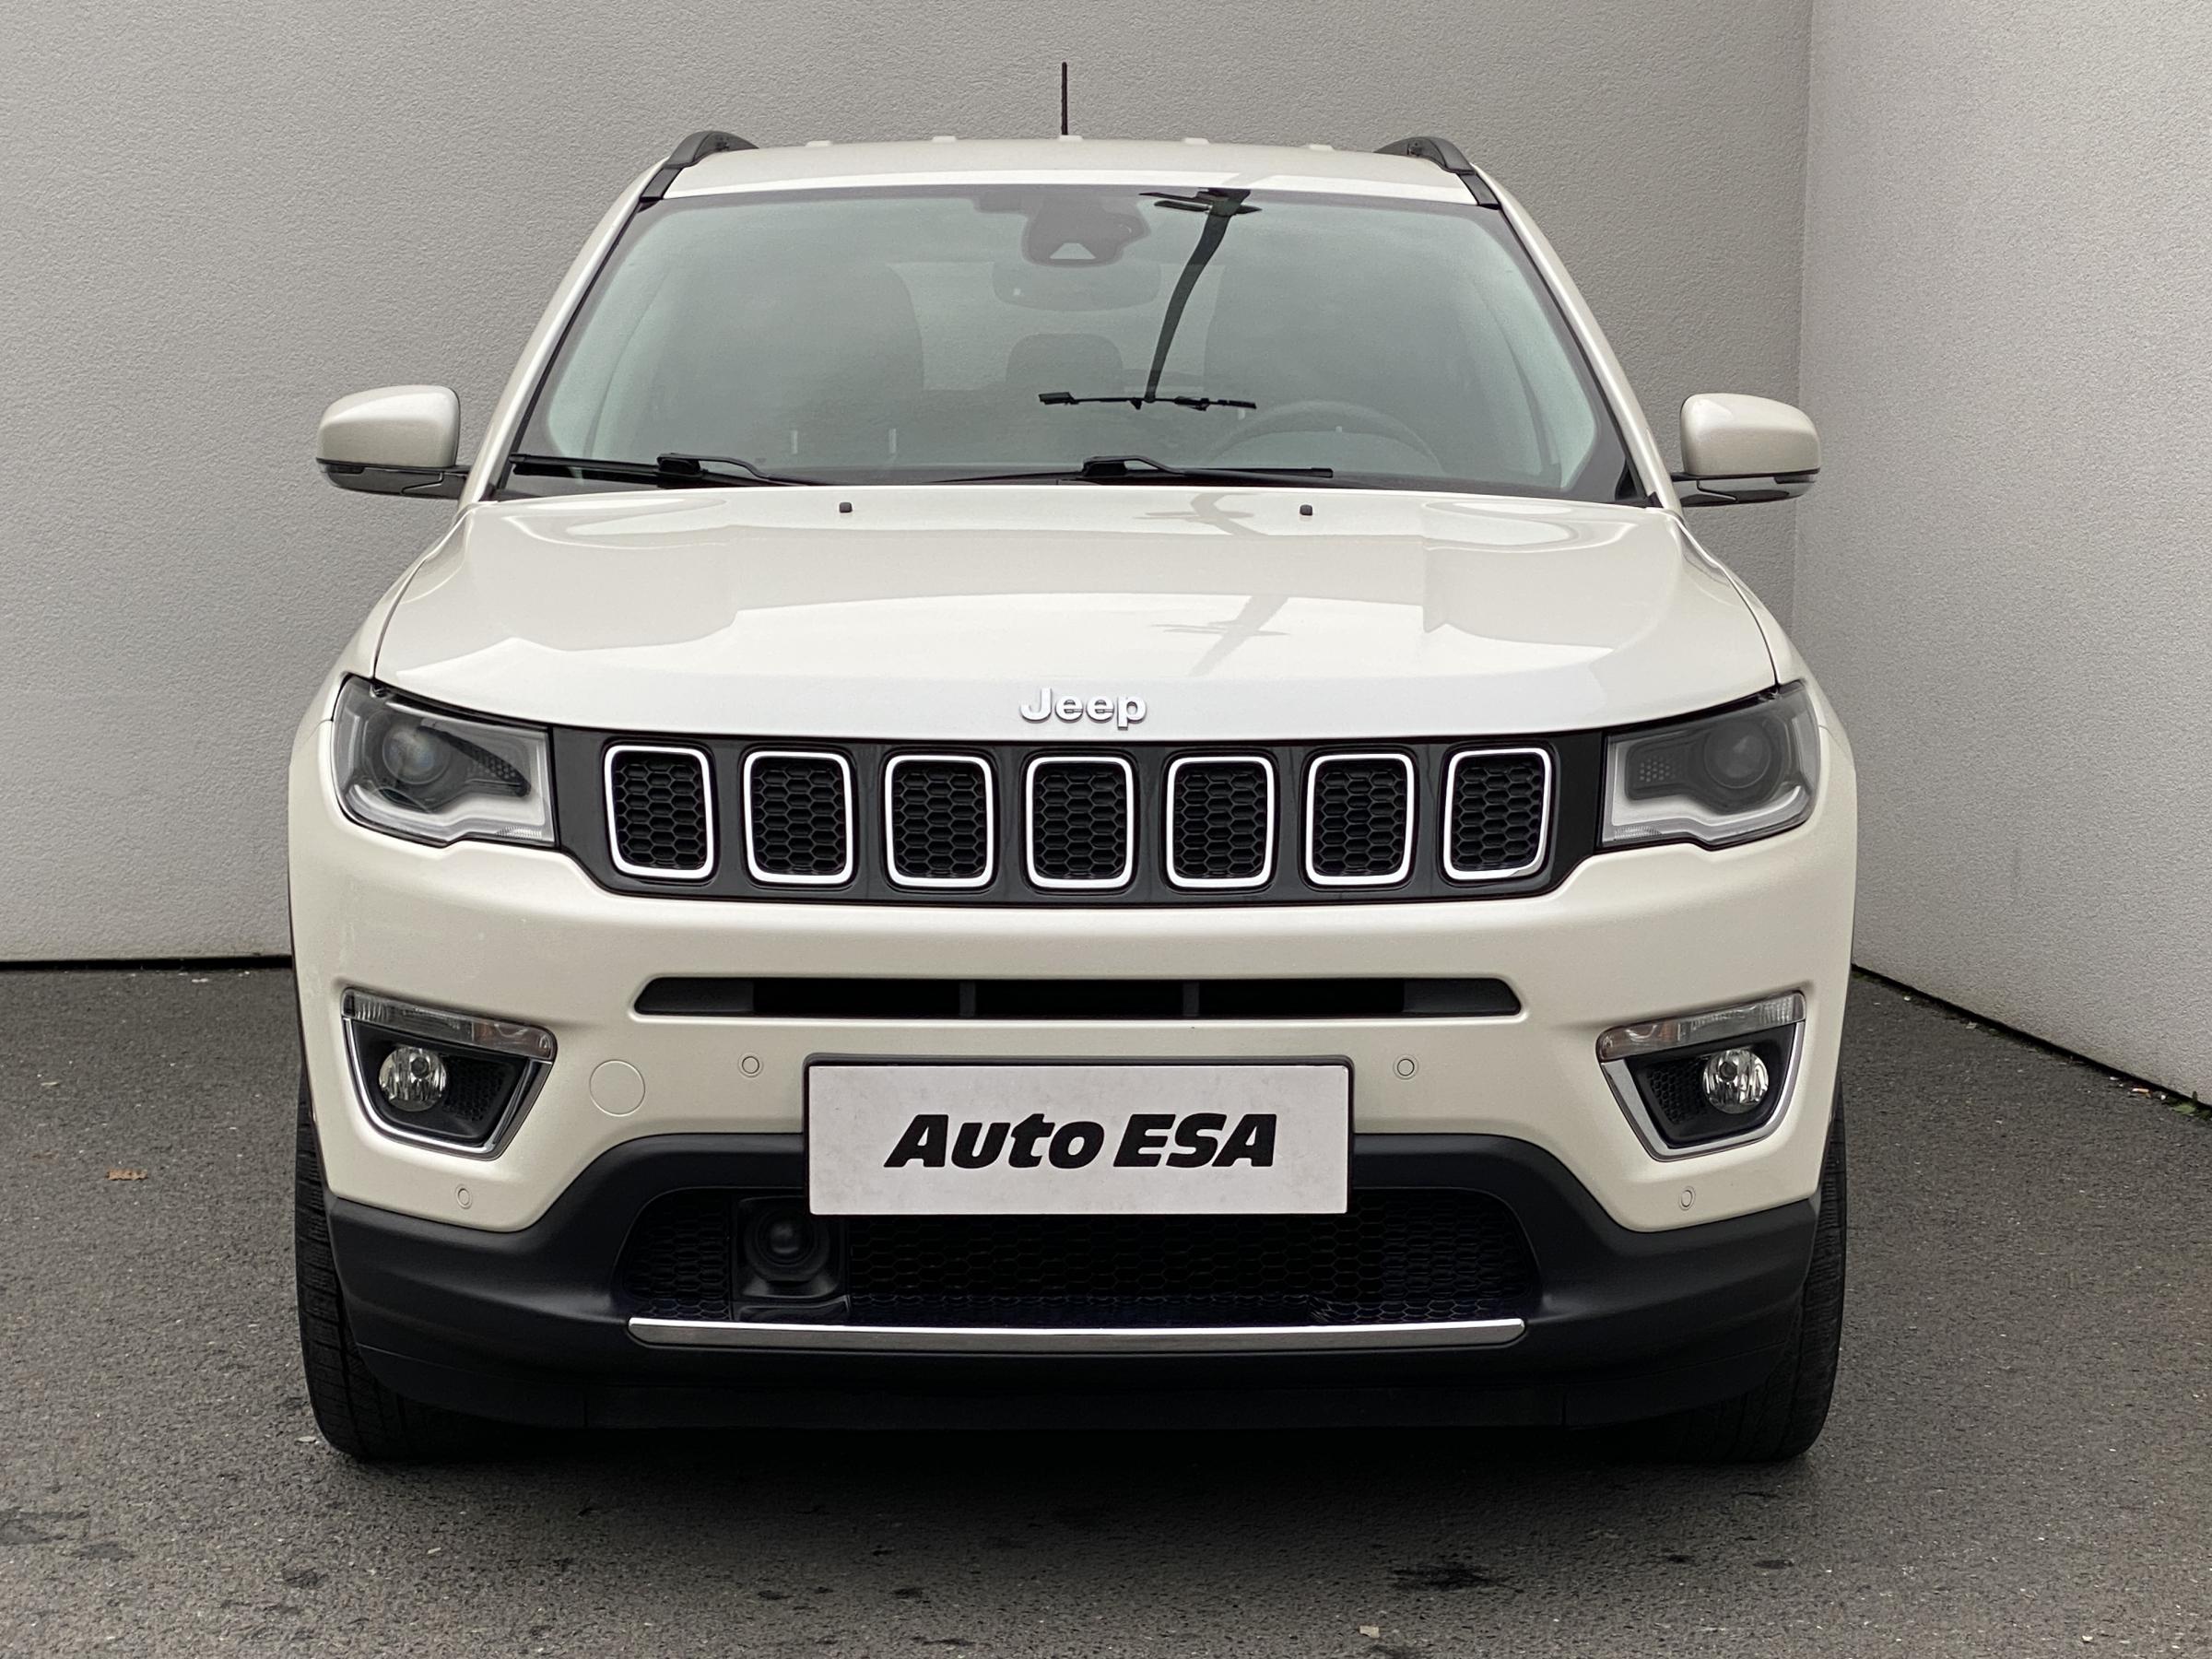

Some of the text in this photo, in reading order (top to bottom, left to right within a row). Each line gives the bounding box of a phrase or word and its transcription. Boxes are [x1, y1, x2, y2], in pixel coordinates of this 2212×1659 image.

[1019, 688, 1147, 730] Jeep
[883, 1112, 1277, 1169] Auto ESA
